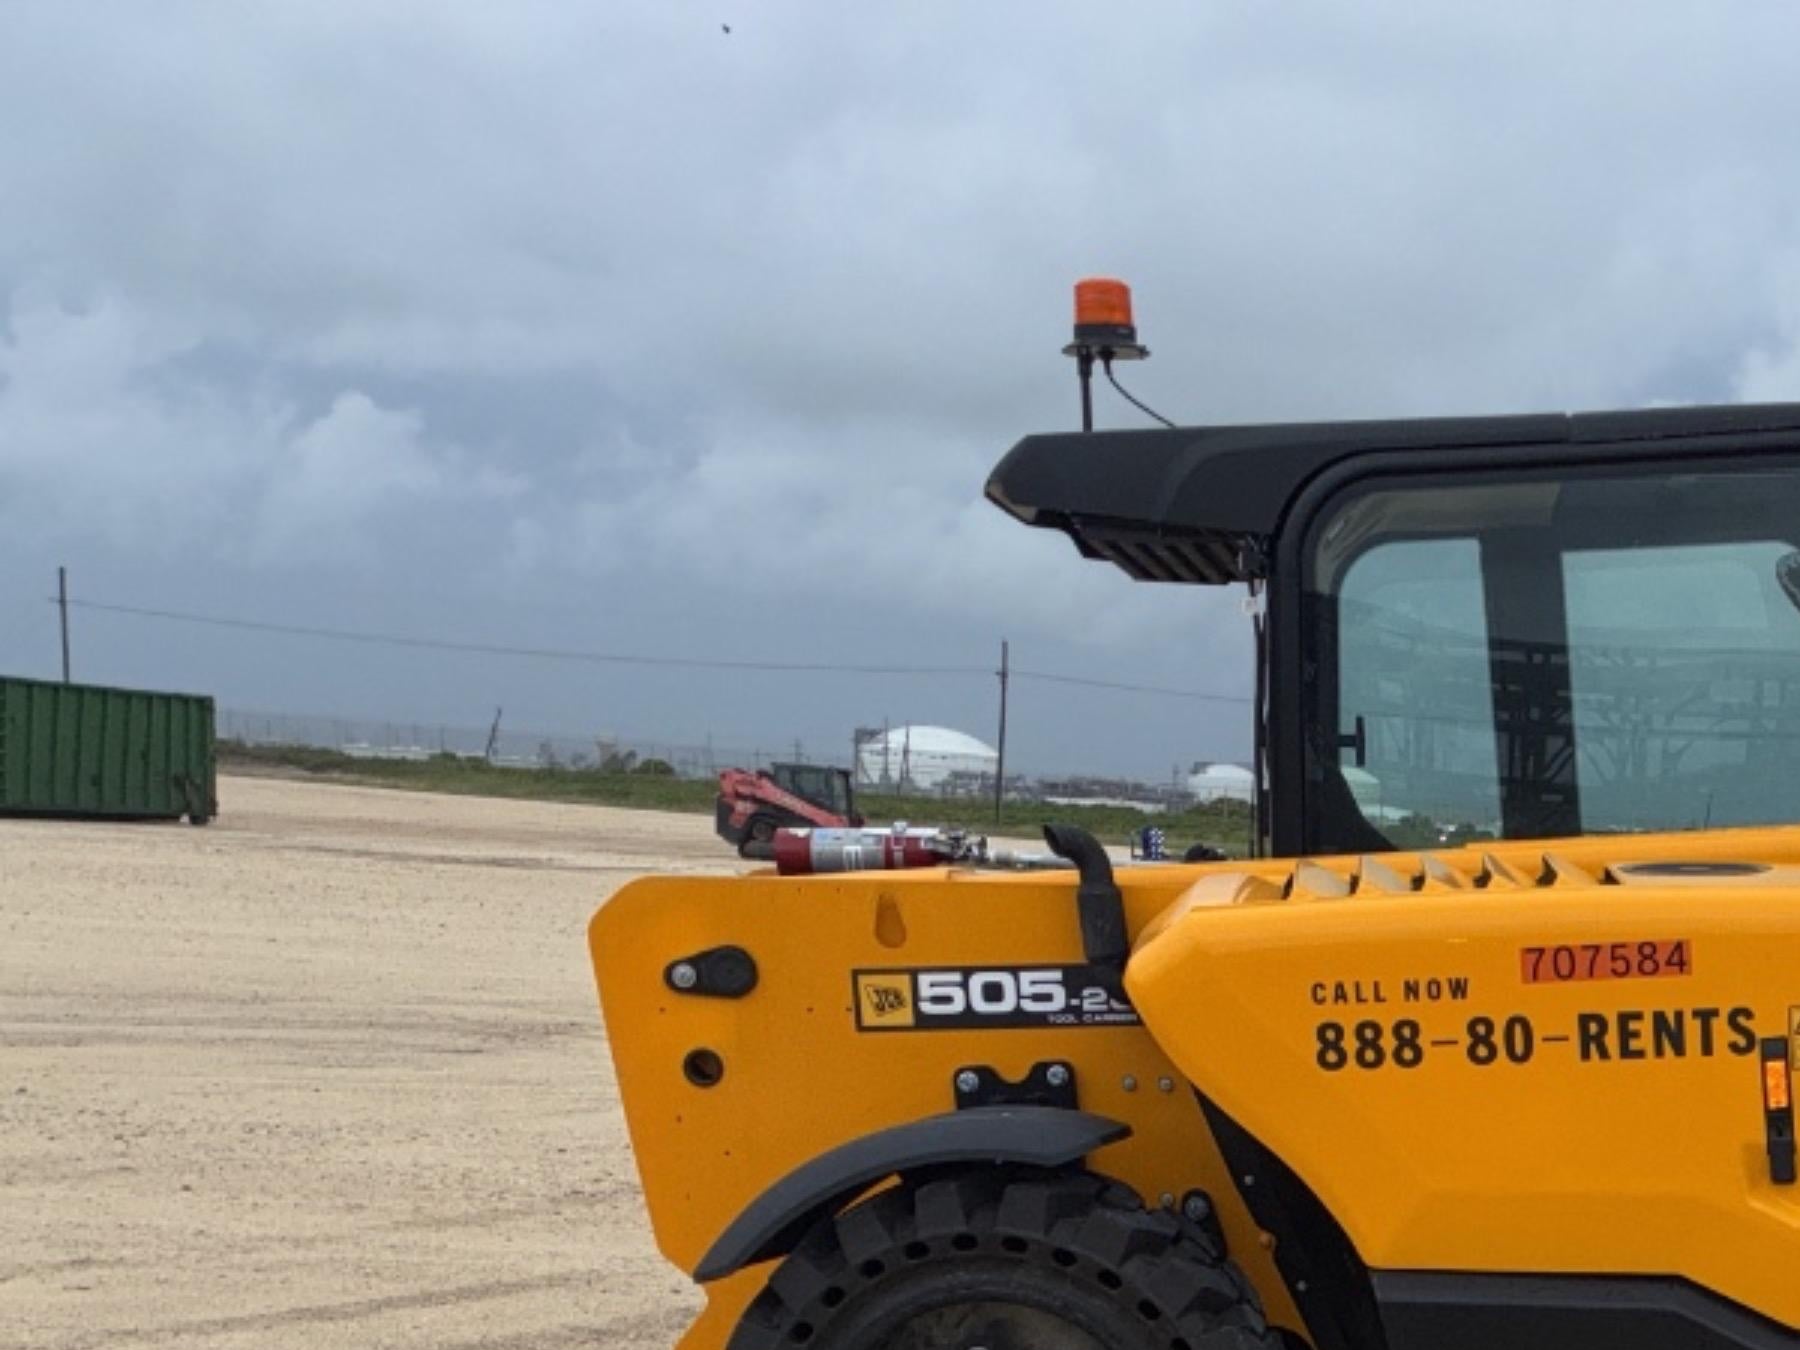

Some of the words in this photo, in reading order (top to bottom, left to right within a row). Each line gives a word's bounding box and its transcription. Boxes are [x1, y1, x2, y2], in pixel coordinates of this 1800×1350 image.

[1524, 941, 1689, 981] 707584
[1311, 980, 1387, 1005] CALL
[1403, 977, 1470, 1001] NOW
[1315, 1007, 1757, 1071] 888-80-RENTS
